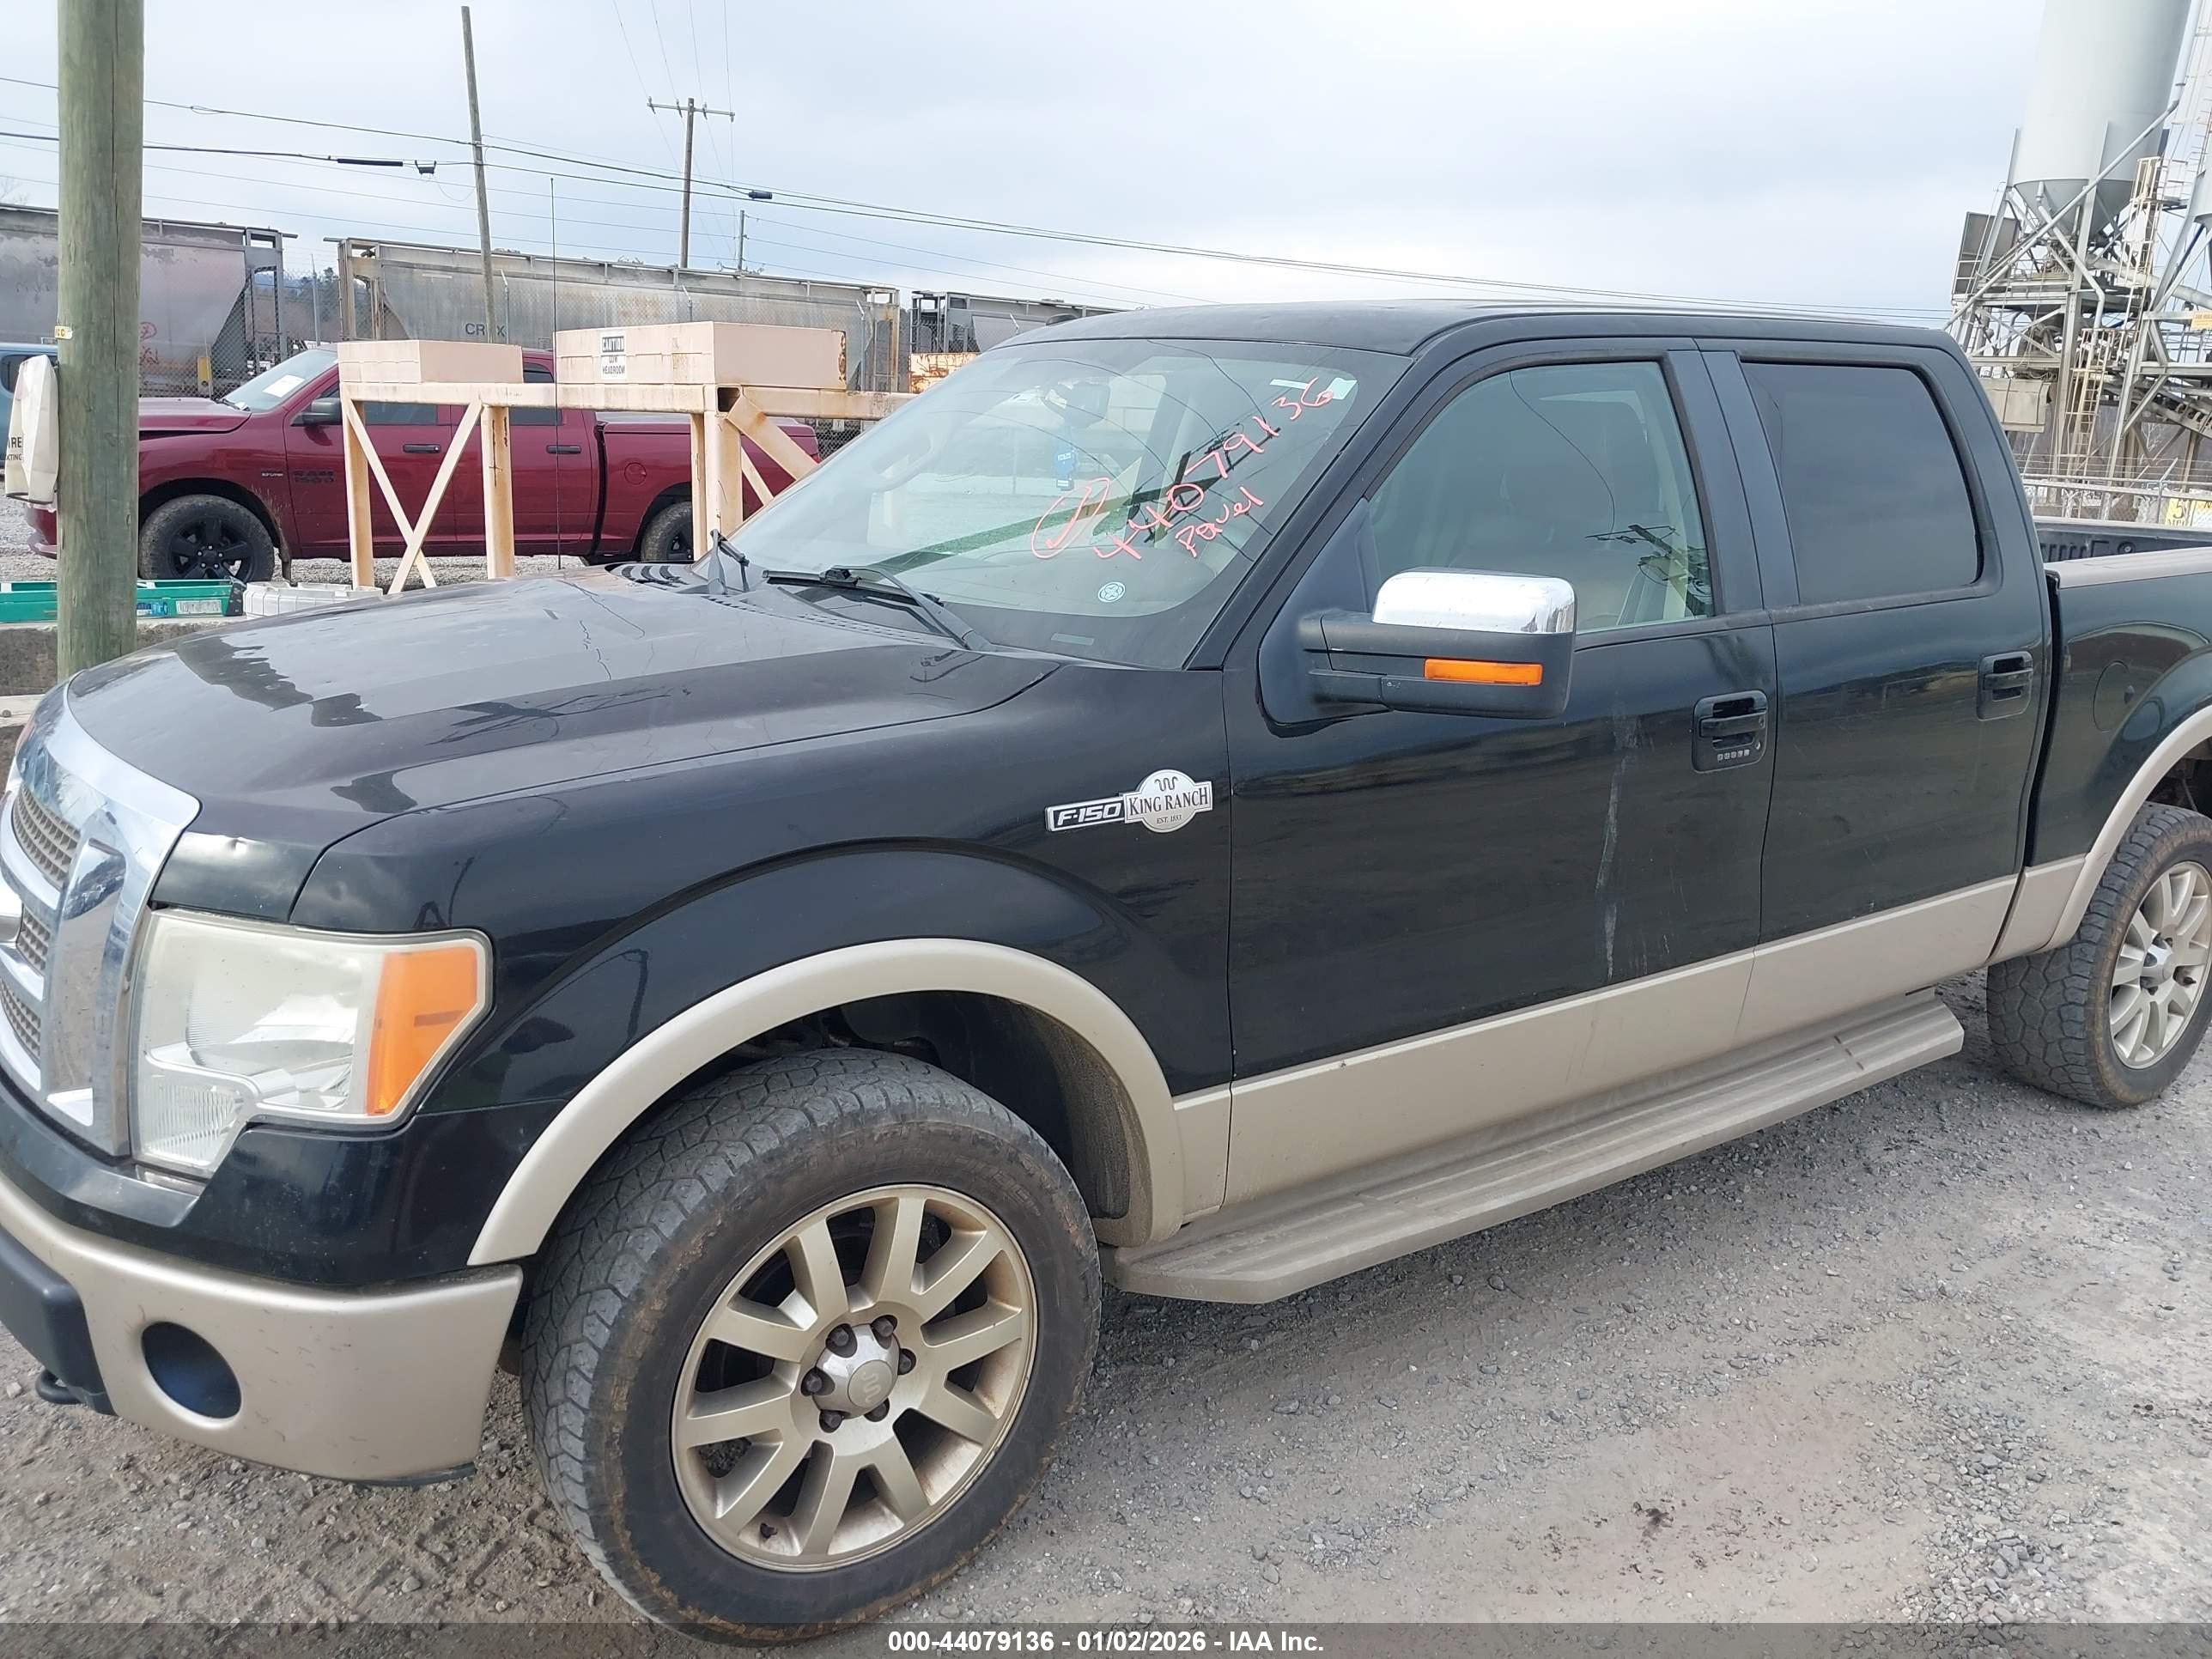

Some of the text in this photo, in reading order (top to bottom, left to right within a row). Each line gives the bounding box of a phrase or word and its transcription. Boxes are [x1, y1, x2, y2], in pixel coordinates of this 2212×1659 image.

[465, 323, 505, 337] CRX
[603, 337, 624, 352] CAUTION
[2172, 499, 2185, 519] 5
[1128, 787, 1209, 816] KING RANCH
[1057, 802, 1122, 826] F-150
